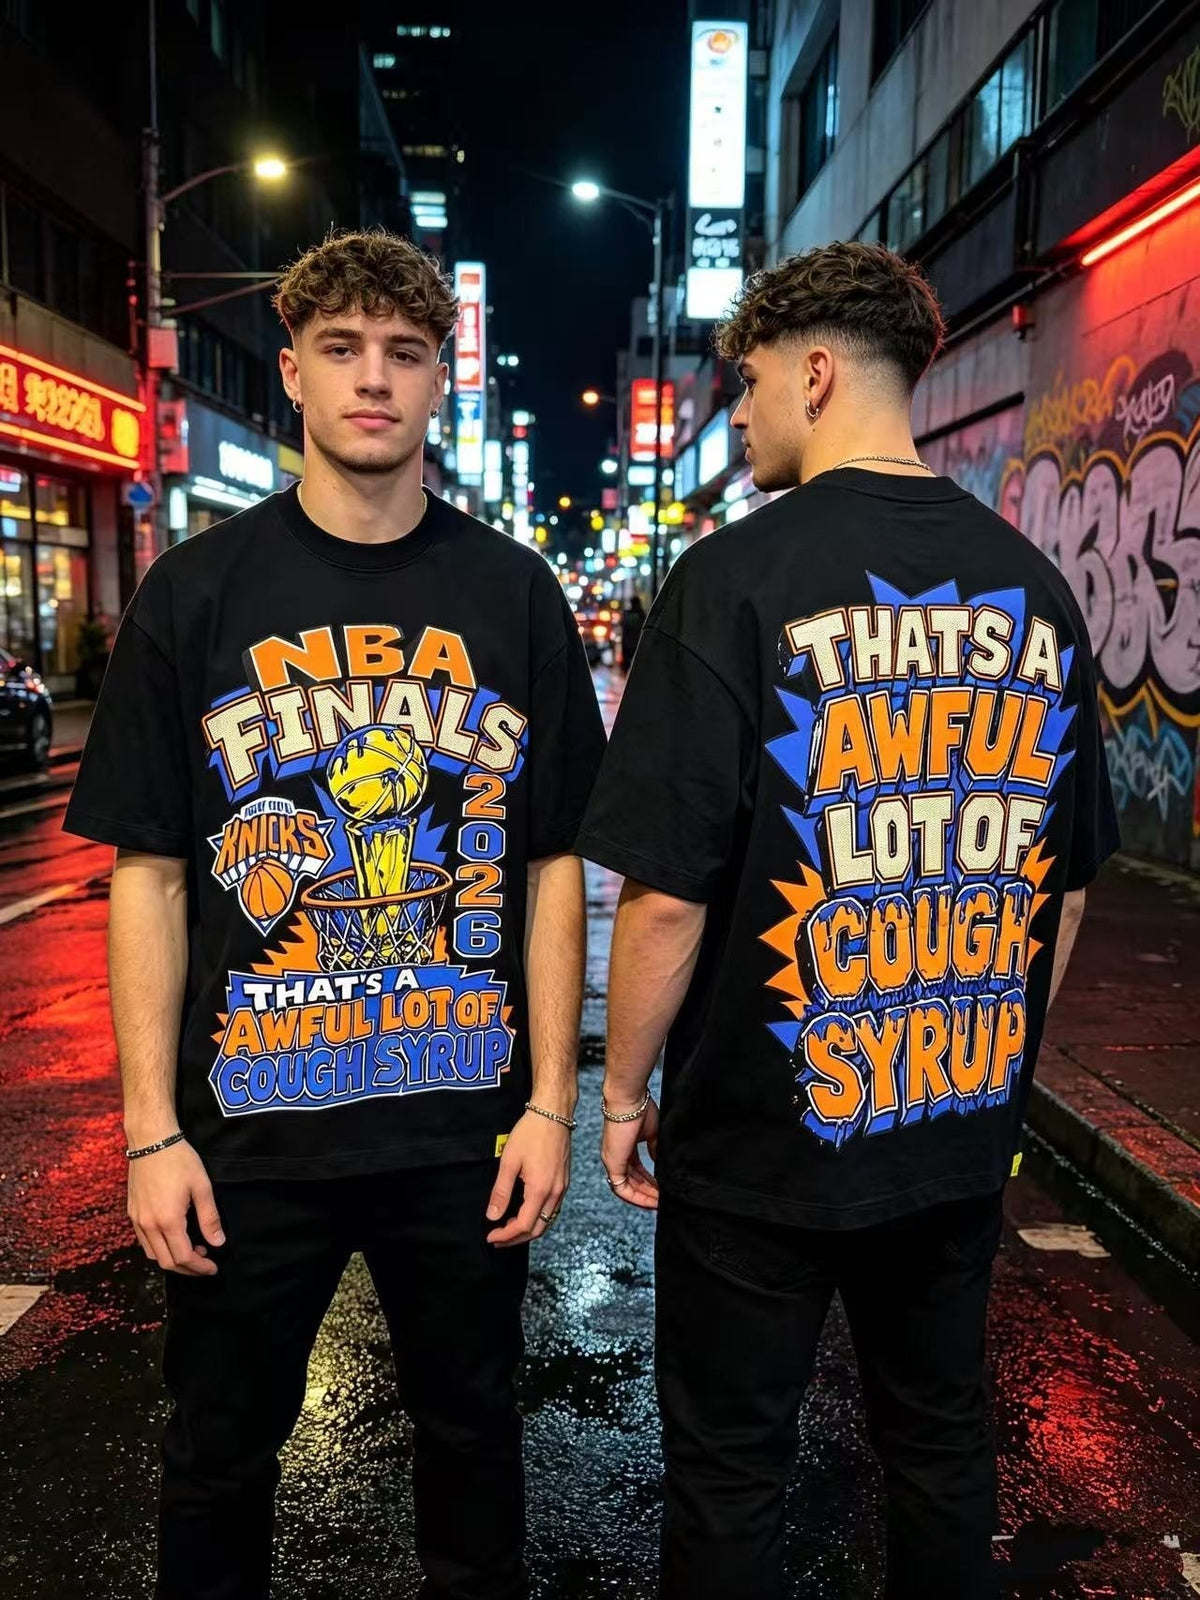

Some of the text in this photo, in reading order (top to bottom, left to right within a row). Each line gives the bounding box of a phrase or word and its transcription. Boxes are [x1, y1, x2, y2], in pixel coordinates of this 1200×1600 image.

[248, 624, 476, 691] NBA
[785, 605, 1063, 693] THATS A
[201, 679, 528, 790] FINALS
[813, 686, 1055, 796] AWFUL
[214, 812, 329, 875] KNICKS
[453, 773, 506, 958] 2026
[824, 791, 1047, 890] LOT OF
[807, 882, 1033, 1001] COUGH
[221, 986, 500, 1058] AWFUL LOT OF
[243, 968, 420, 1011] THAT'S A
[217, 1028, 508, 1109] COUGH SYRUP
[804, 988, 1027, 1124] SYRUP
